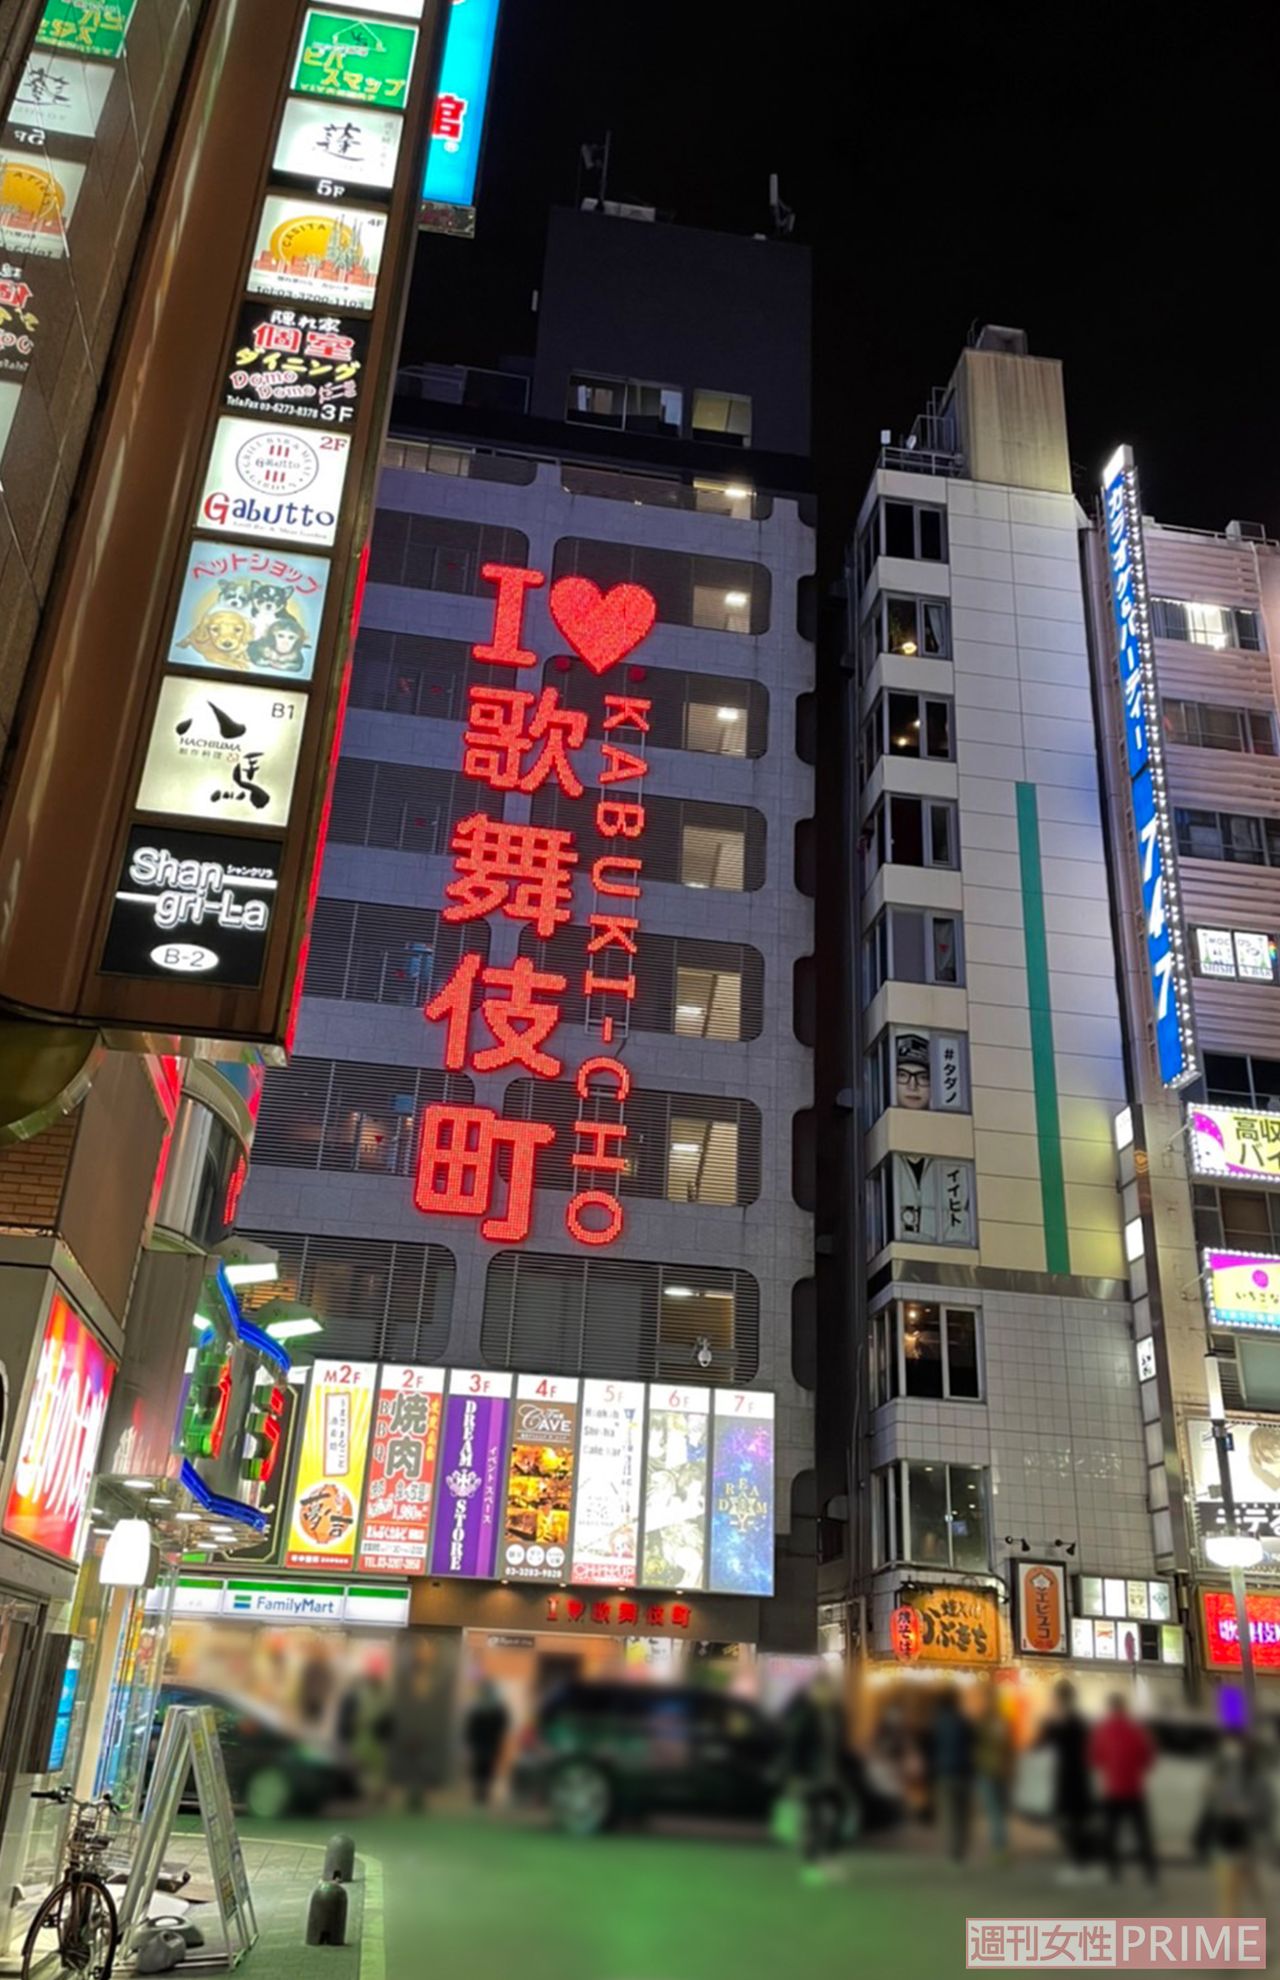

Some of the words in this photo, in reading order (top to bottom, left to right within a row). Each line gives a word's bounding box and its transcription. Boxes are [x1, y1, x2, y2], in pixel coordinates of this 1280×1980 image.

[316, 180, 345, 198] 5F
[367, 218, 385, 228] 4F
[282, 223, 327, 248] CASITA
[270, 309, 341, 332] 隠れ家
[253, 321, 355, 362] 個室
[235, 346, 361, 382] ダイニング
[229, 369, 299, 391] Domo
[255, 383, 317, 400] Domo
[320, 403, 354, 422] 3F
[319, 435, 349, 452] 2F
[203, 492, 335, 526] Gabutto
[471, 563, 546, 668] I
[271, 702, 295, 720] B1
[129, 845, 224, 890] Shan
[153, 889, 268, 933] gri-La
[163, 947, 205, 968] B-2
[414, 685, 589, 1243] 歌舞伎町
[566, 694, 651, 1245] KABUKI-CHO
[947, 1169, 962, 1227] イイヒト
[323, 1365, 361, 1385] M2F
[402, 1369, 424, 1388] 2F
[469, 1374, 491, 1393] 3F
[535, 1379, 557, 1398] 4F
[603, 1384, 623, 1402] 5F
[668, 1390, 689, 1408] 6F
[734, 1395, 754, 1413] 7F
[385, 1390, 431, 1479] 焼肉
[459, 1400, 477, 1468] DREAM
[450, 1499, 468, 1571] STORE
[256, 1595, 334, 1613] FamilyMart
